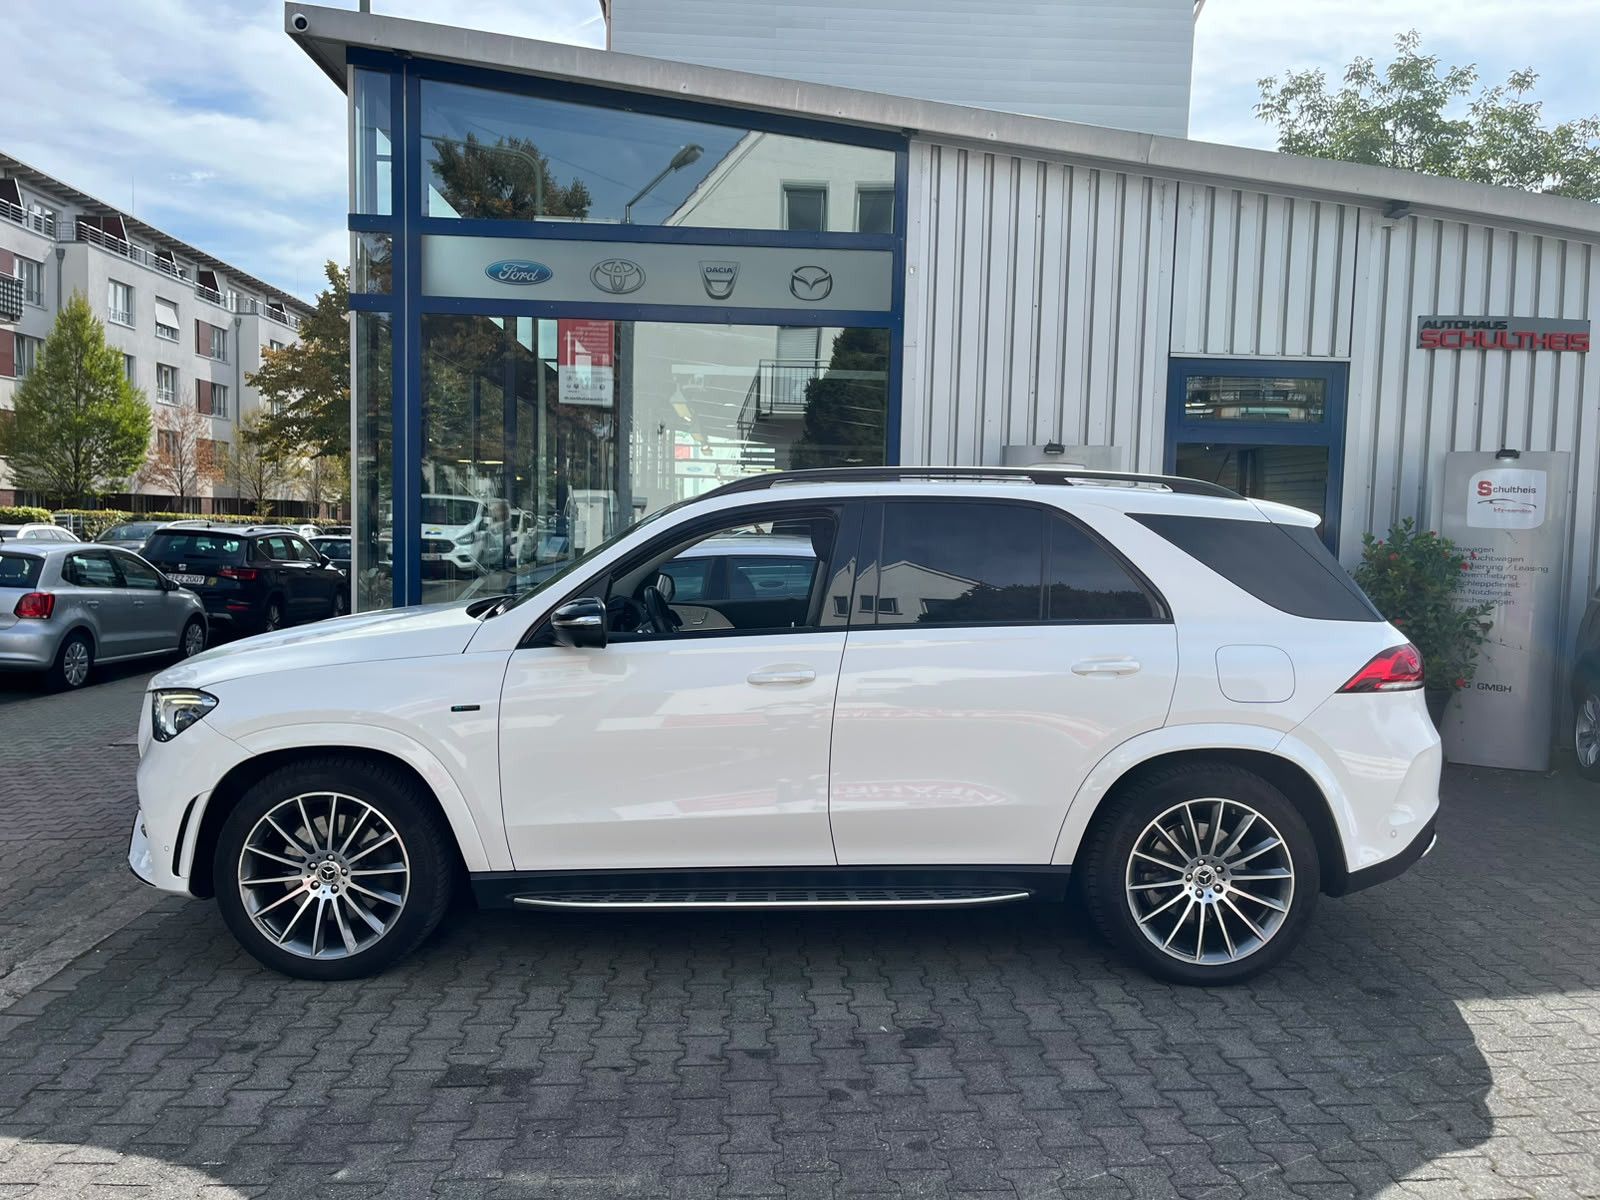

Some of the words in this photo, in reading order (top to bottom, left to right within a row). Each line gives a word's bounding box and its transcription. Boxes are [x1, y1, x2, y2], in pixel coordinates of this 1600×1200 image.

[498, 263, 540, 281] Ford
[1422, 320, 1508, 330] AUTOHAUS
[1420, 330, 1590, 352] SCHULTHEIS
[1477, 480, 1537, 496] Schultheis
[1513, 565, 1549, 573] Leasing
[1468, 589, 1513, 597] Notdienst
[1477, 682, 1512, 692] GMBH
